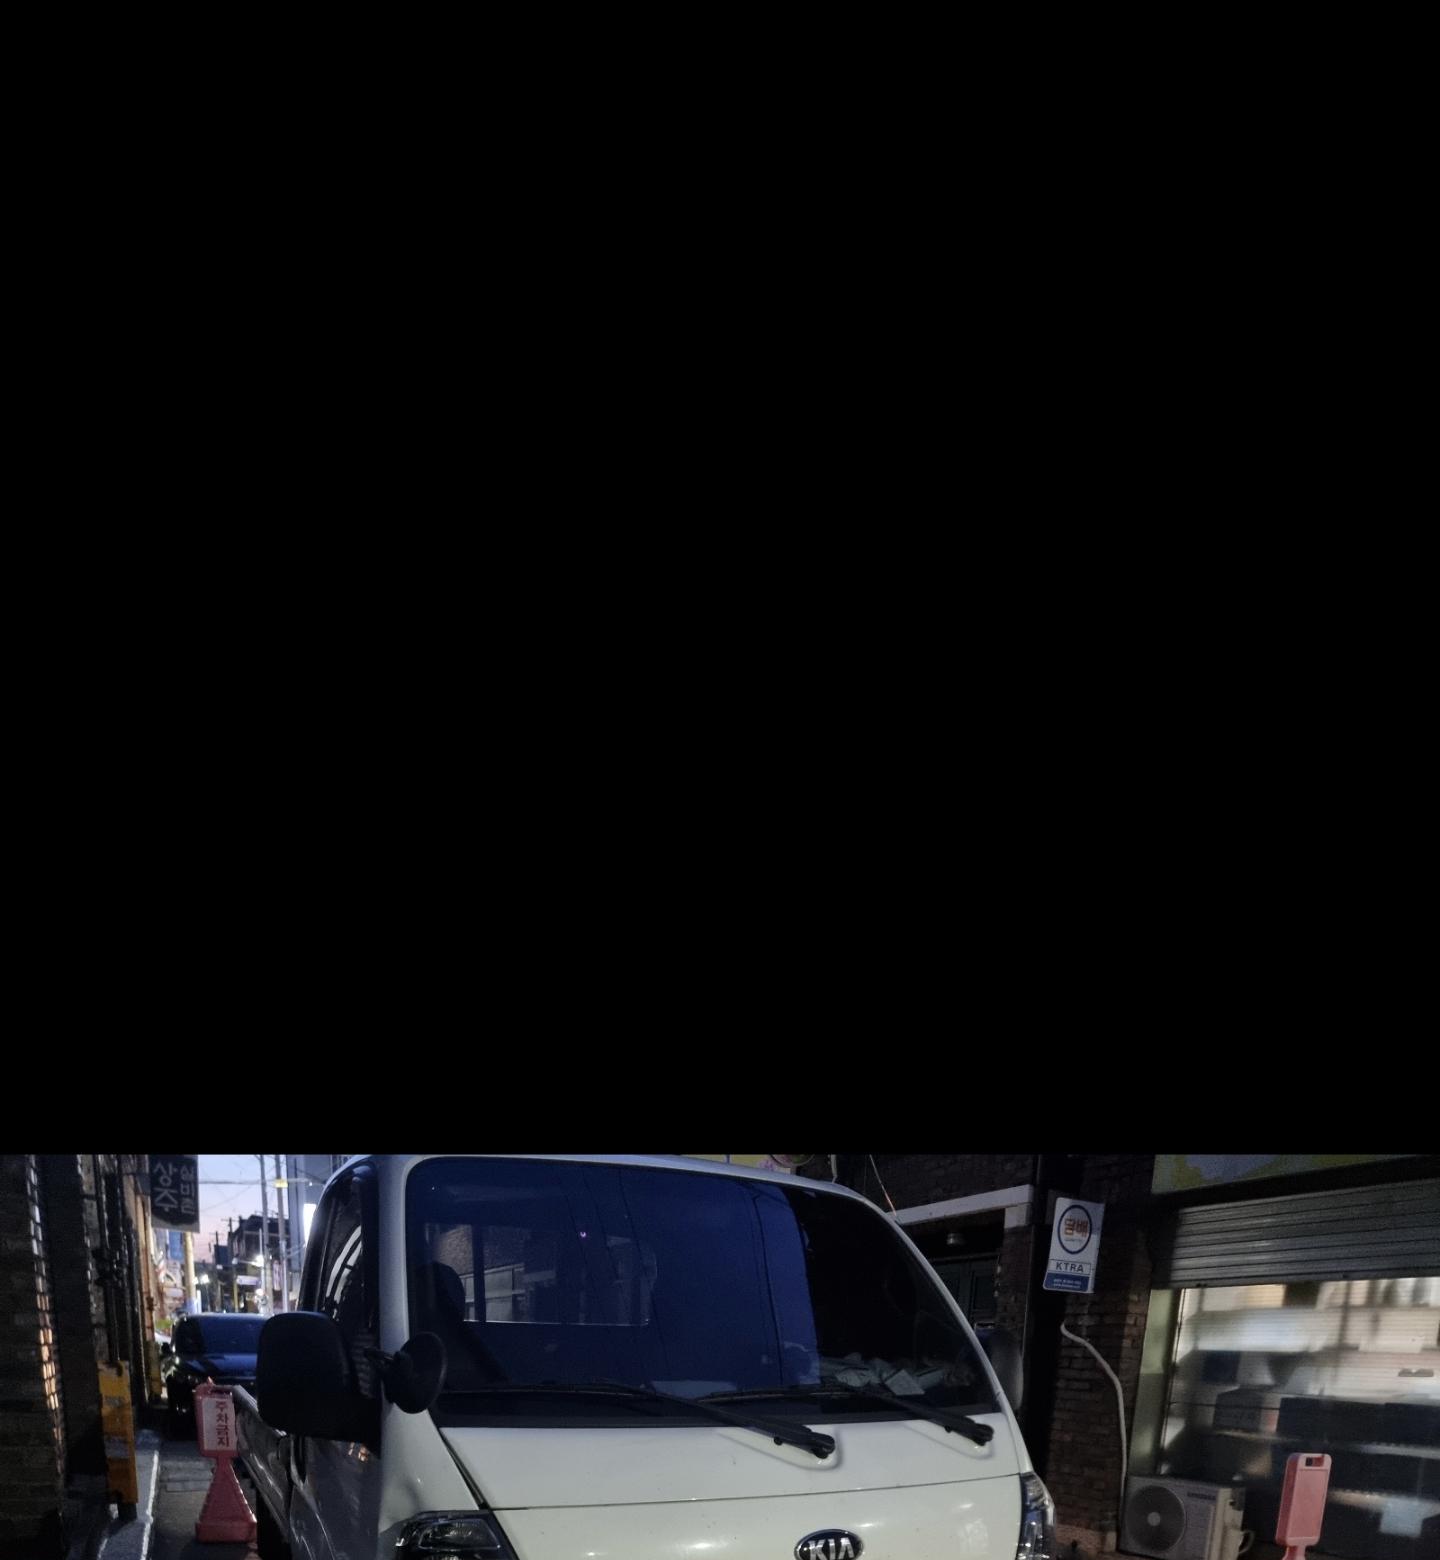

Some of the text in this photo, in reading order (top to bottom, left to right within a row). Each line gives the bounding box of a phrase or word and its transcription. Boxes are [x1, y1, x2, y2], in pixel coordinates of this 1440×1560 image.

[152, 1161, 179, 1212] 상주
[1064, 1215, 1089, 1238] 담배
[1055, 1261, 1084, 1273] KTRA
[215, 1400, 230, 1448] 주차금지
